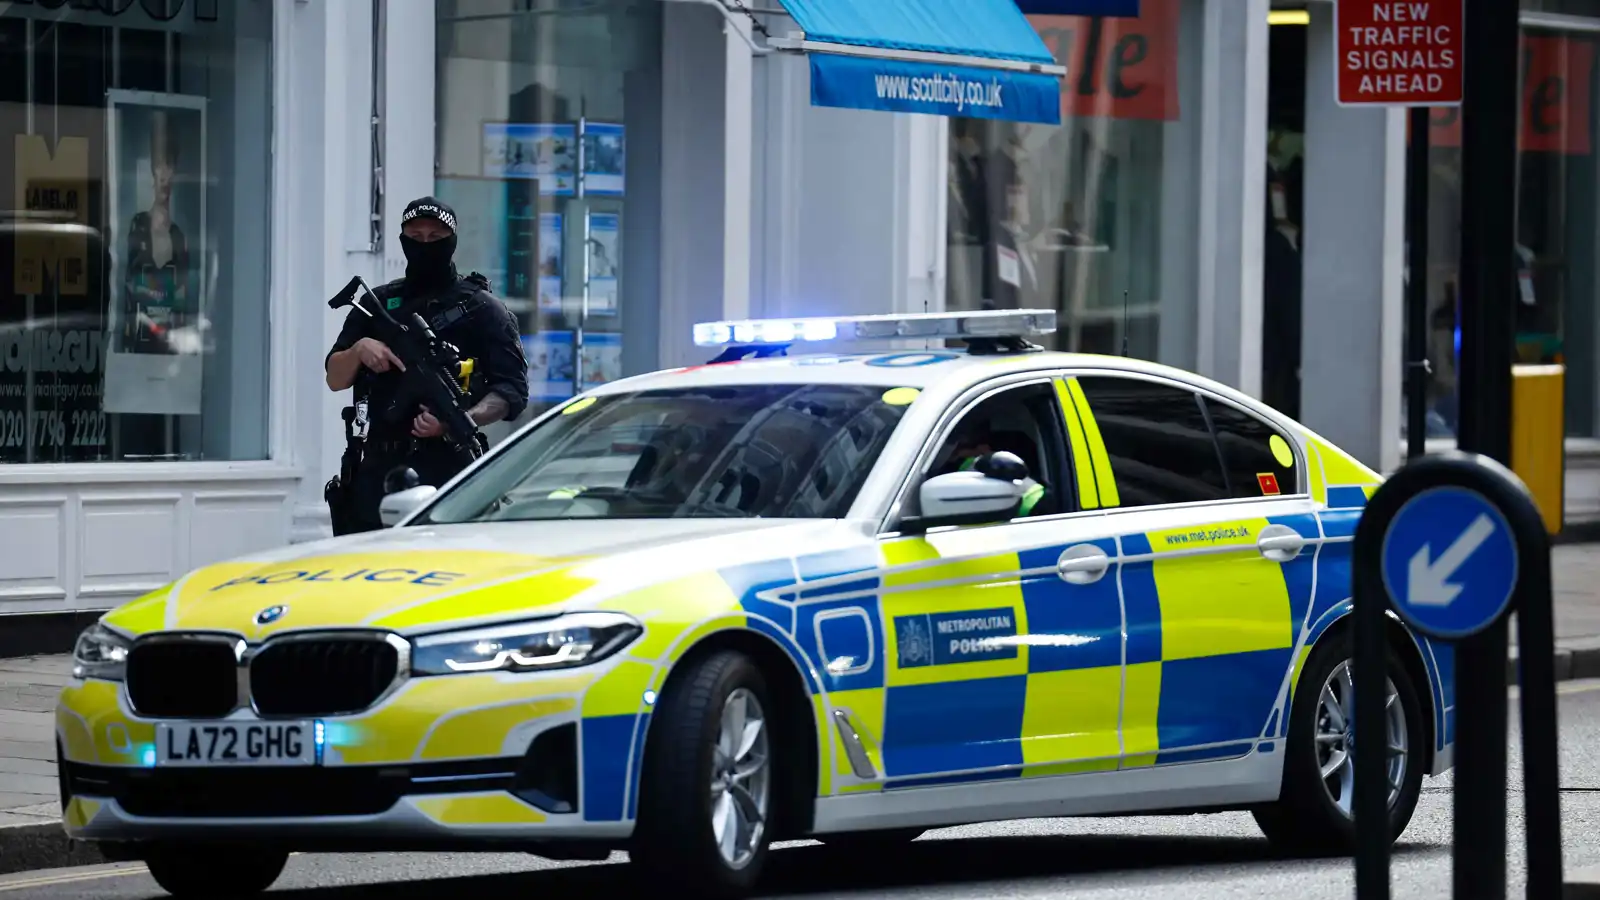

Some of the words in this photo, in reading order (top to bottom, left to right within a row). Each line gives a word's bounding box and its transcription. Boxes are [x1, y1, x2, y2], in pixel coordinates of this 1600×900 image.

[1373, 3, 1429, 21] NEW
[1349, 25, 1450, 45] TRAFFIC
[1347, 49, 1454, 69] SIGNALS
[875, 72, 1003, 112] www.scottcity.co.uk
[1358, 74, 1443, 93] AHEAD
[418, 204, 438, 212] POLICE
[0, 378, 105, 402] www.niandguy.co.u
[72, 410, 106, 446] 2222
[1165, 526, 1250, 543] www.met.police.uk
[208, 568, 466, 592] POLICE
[938, 616, 1010, 633] METROPOLITAN
[167, 726, 238, 761] LA72
[246, 725, 302, 758] GHG
